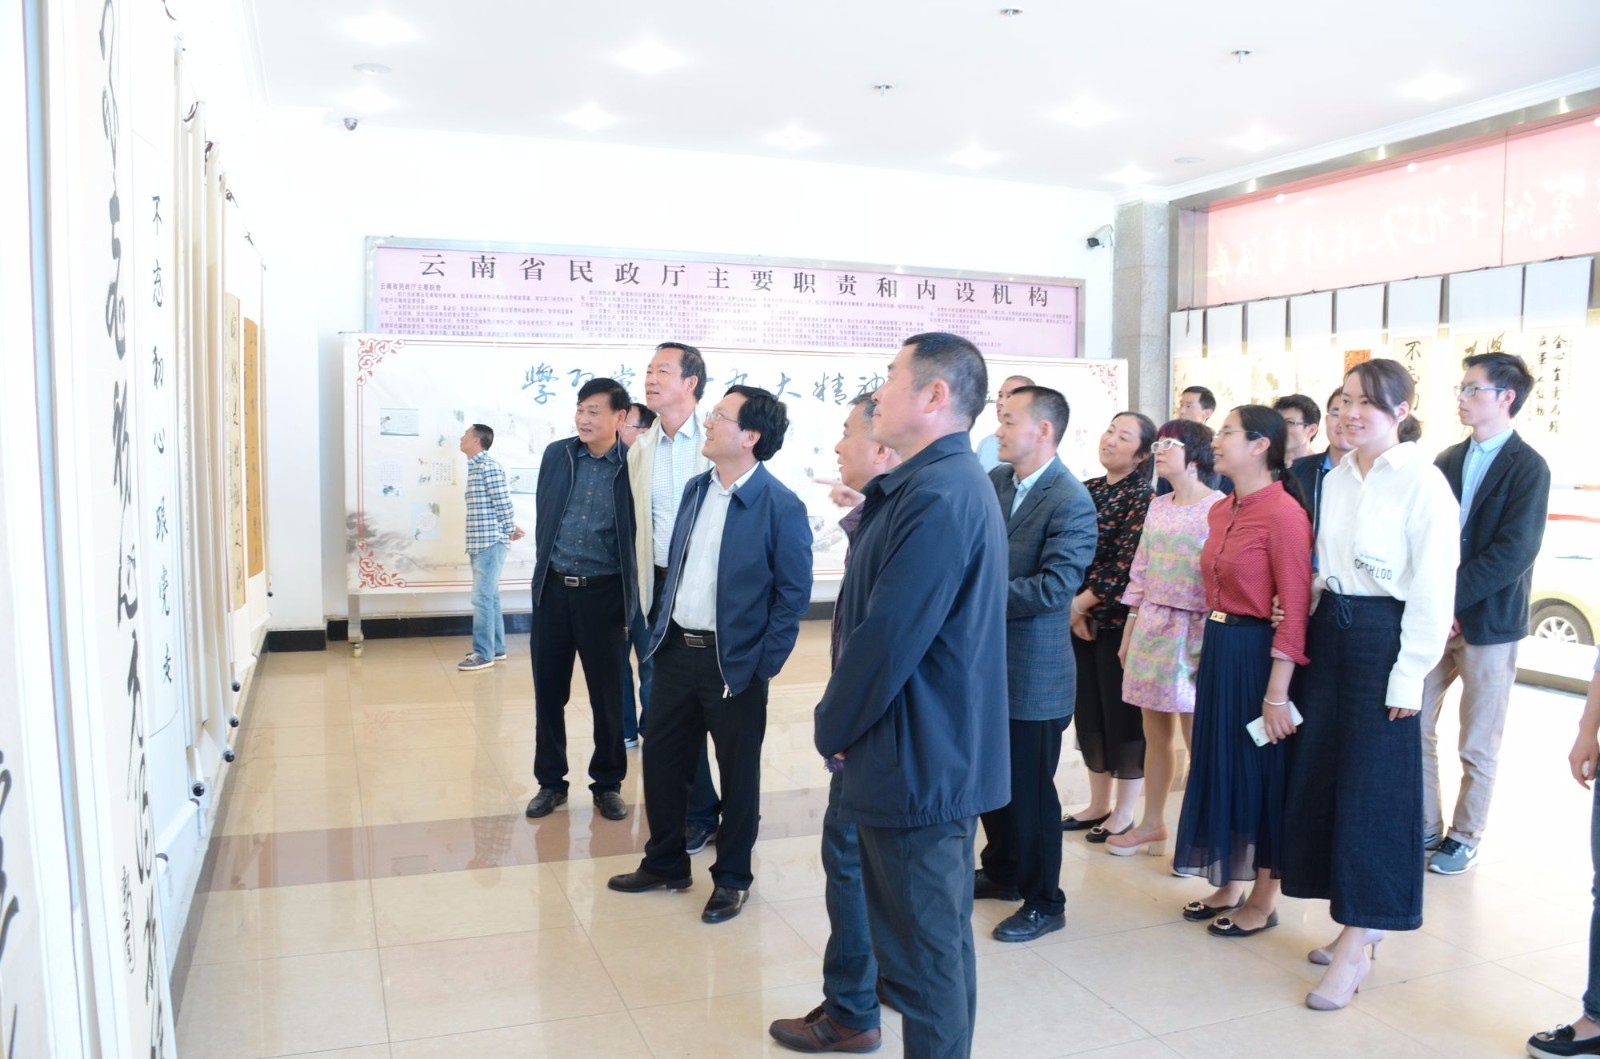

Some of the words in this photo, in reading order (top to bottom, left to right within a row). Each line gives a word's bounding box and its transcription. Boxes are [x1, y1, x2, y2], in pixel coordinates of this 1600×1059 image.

[419, 252, 1050, 308] 云南省民政厅主要职责和内设机构
